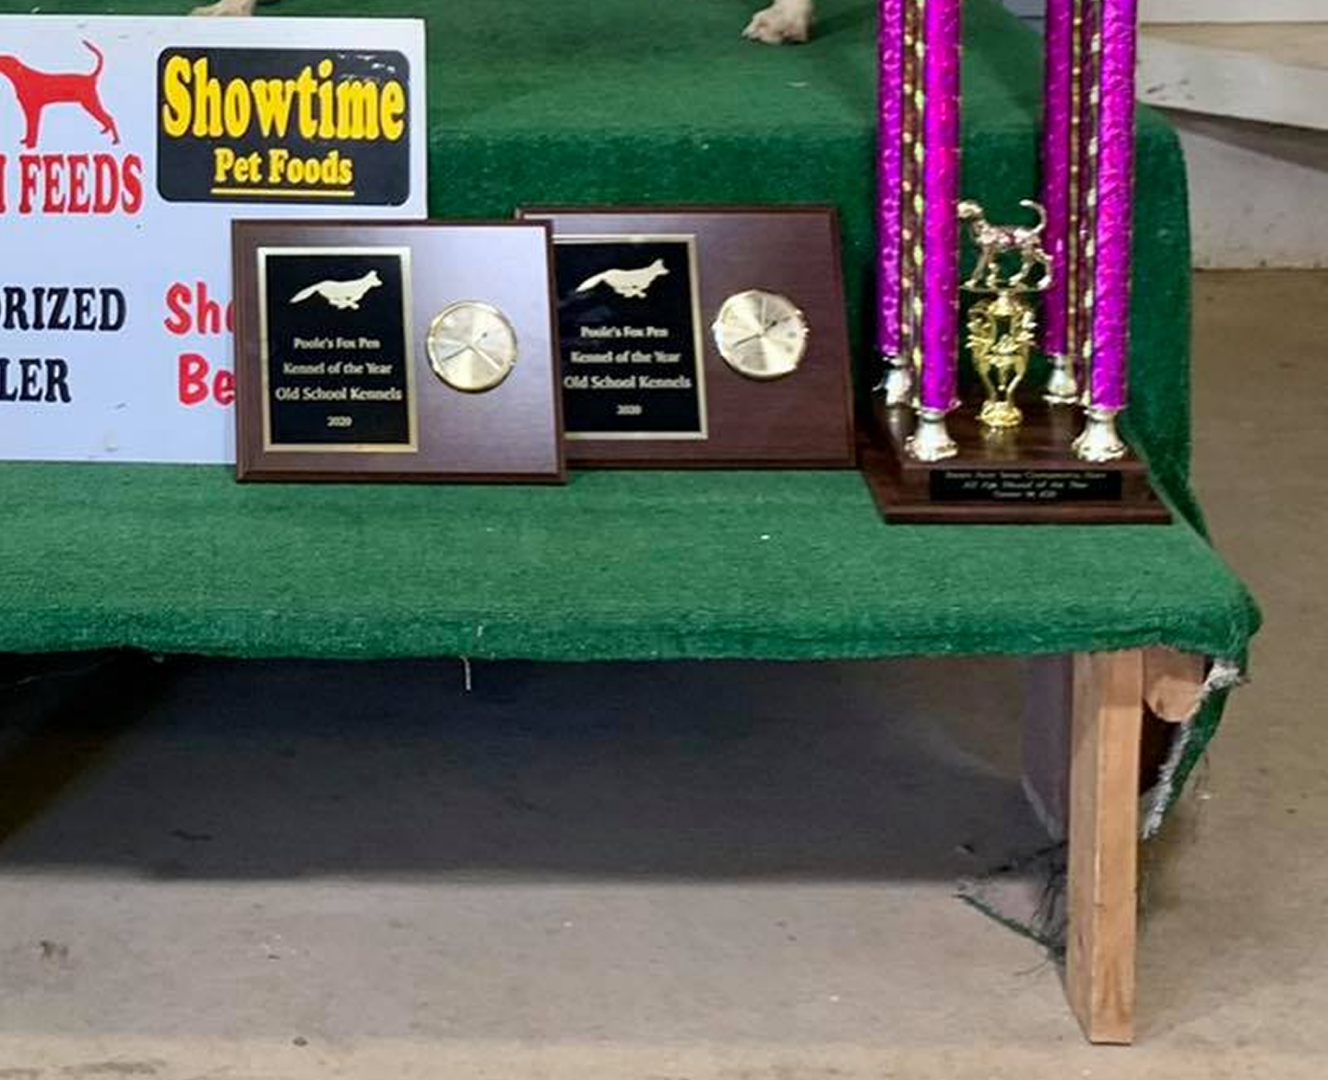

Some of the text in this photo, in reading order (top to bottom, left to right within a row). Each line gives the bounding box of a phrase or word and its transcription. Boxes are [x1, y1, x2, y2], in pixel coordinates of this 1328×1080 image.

[162, 56, 406, 141] Showtime
[214, 147, 353, 185] Pet Foods
[18, 154, 143, 215] FEEDS
[164, 281, 236, 335] Sh
[336, 337, 357, 350] Fox
[615, 350, 631, 363] of
[631, 350, 652, 363] the
[653, 350, 681, 363] Year
[283, 362, 393, 375] Kennel of the Year
[563, 375, 693, 389] Old School Kennels
[275, 386, 403, 400] Old School Kennels
